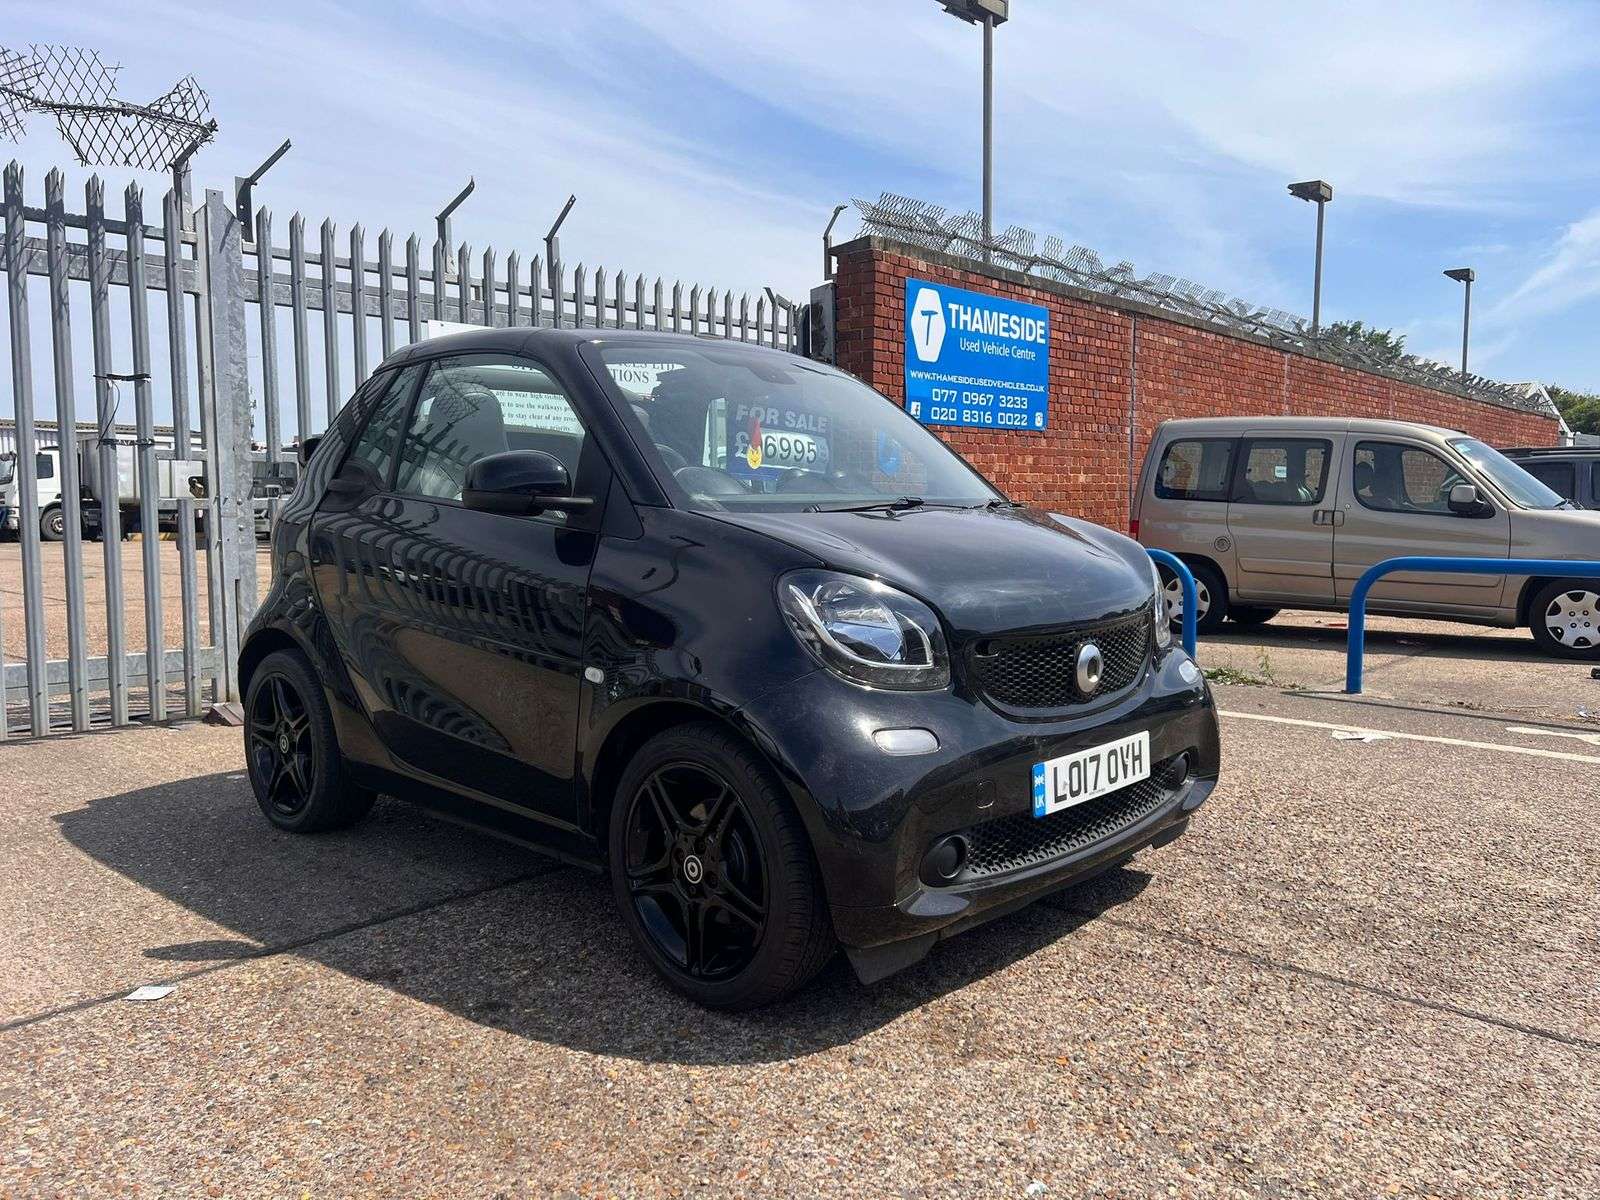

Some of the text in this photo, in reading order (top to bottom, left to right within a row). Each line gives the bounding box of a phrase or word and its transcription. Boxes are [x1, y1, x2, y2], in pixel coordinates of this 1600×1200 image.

[948, 303, 1046, 344] THAMESIDE
[959, 337, 1036, 361] Used Vehicle Centre
[910, 370, 1045, 392] WWW.THAMESIDEUSEDVEHICLES.CO.UK
[932, 388, 1028, 409] 077 0967 3233
[736, 404, 828, 433] FOR SALE
[931, 407, 957, 421] 020
[962, 409, 992, 424] 8316
[998, 412, 1028, 426] 0022
[1053, 740, 1142, 804] LO17 OVH
